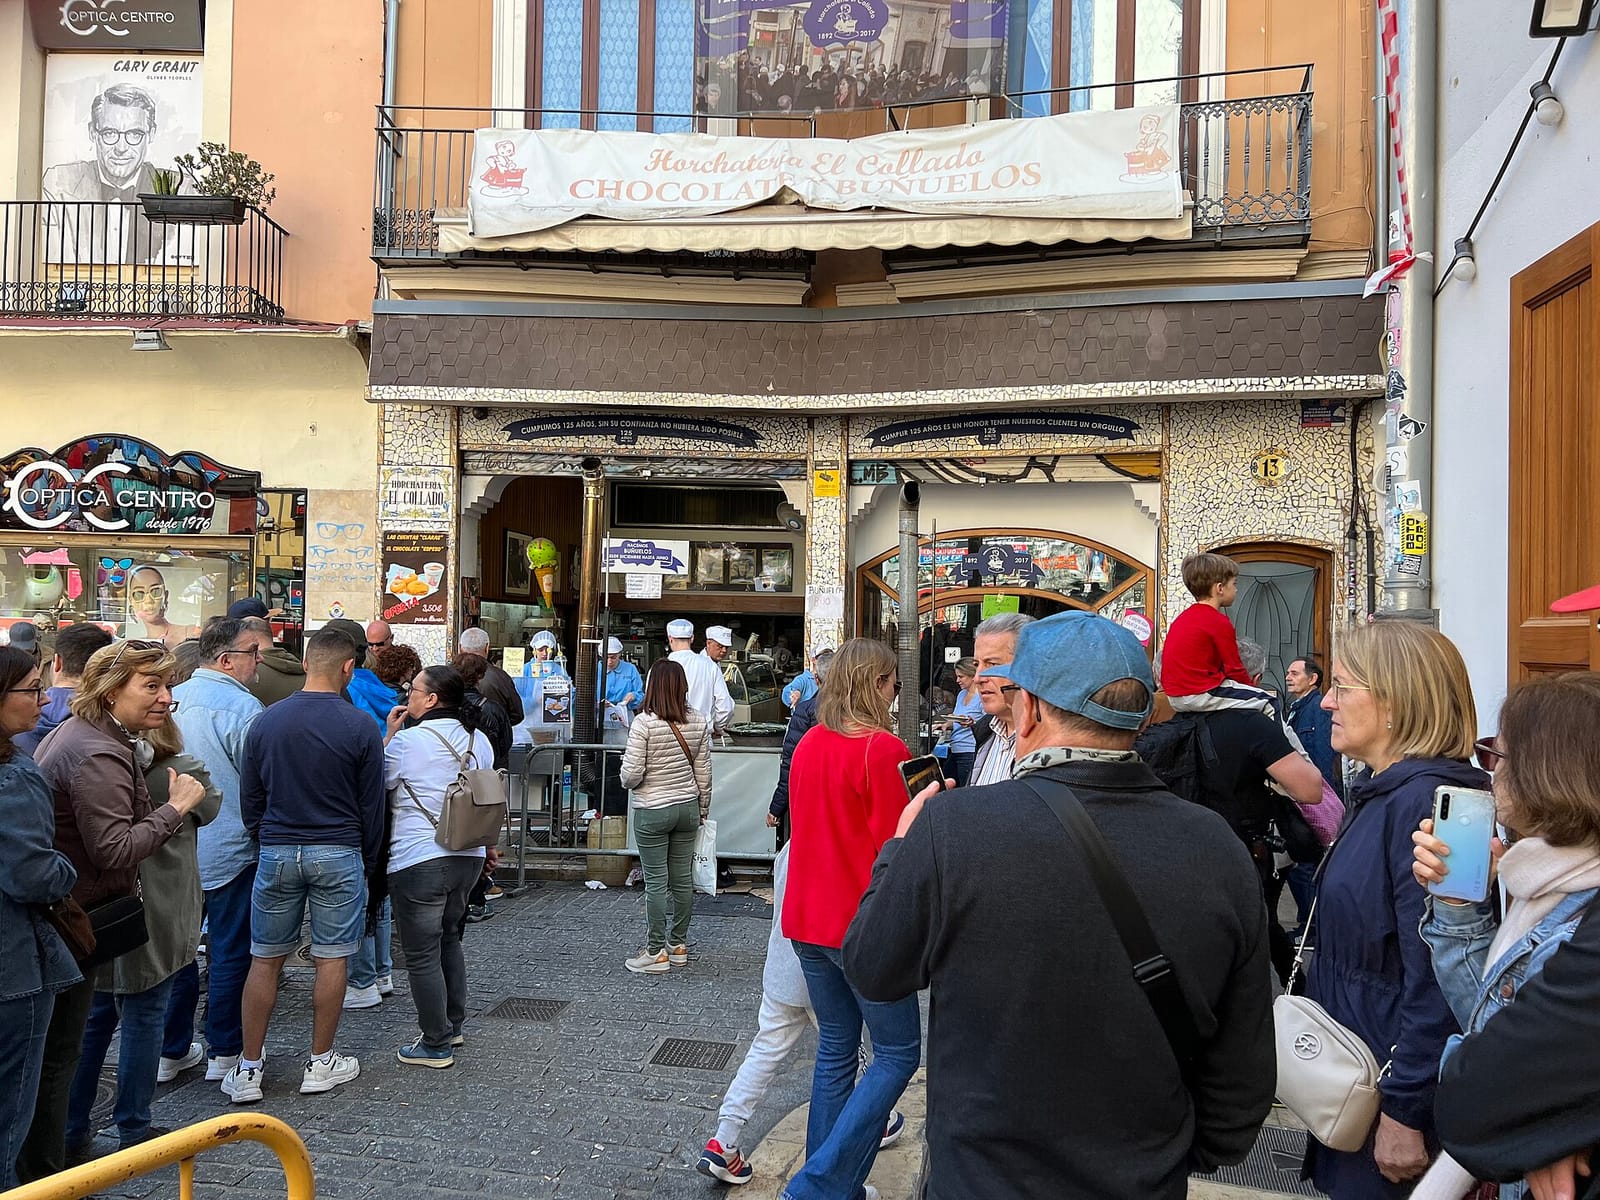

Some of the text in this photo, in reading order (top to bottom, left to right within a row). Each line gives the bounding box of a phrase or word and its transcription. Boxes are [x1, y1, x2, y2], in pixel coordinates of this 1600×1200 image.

[69, 11, 174, 22] OPTICA CENTRO
[114, 60, 199, 72] CARY GRANT
[811, 152, 847, 176] El
[855, 143, 985, 176] Collado
[836, 162, 1042, 196] BUÑUELOS
[521, 423, 560, 434] CUMPLIMOS
[673, 424, 700, 432] HUBIERA
[702, 426, 716, 434] SIDO
[718, 428, 744, 440] POSIBLE
[880, 430, 908, 442] CUMPLIR
[923, 424, 942, 432] AÑOS
[1048, 418, 1078, 427] CLIENTES
[1092, 422, 1125, 432] ORGULLO
[1262, 459, 1278, 476] 13
[392, 480, 442, 490] HORCHATERIA
[20, 488, 215, 509] OPTICA CENTRO
[404, 490, 444, 506] COLLADO
[146, 516, 212, 530] desde 1976
[384, 597, 420, 620] OFERTA
